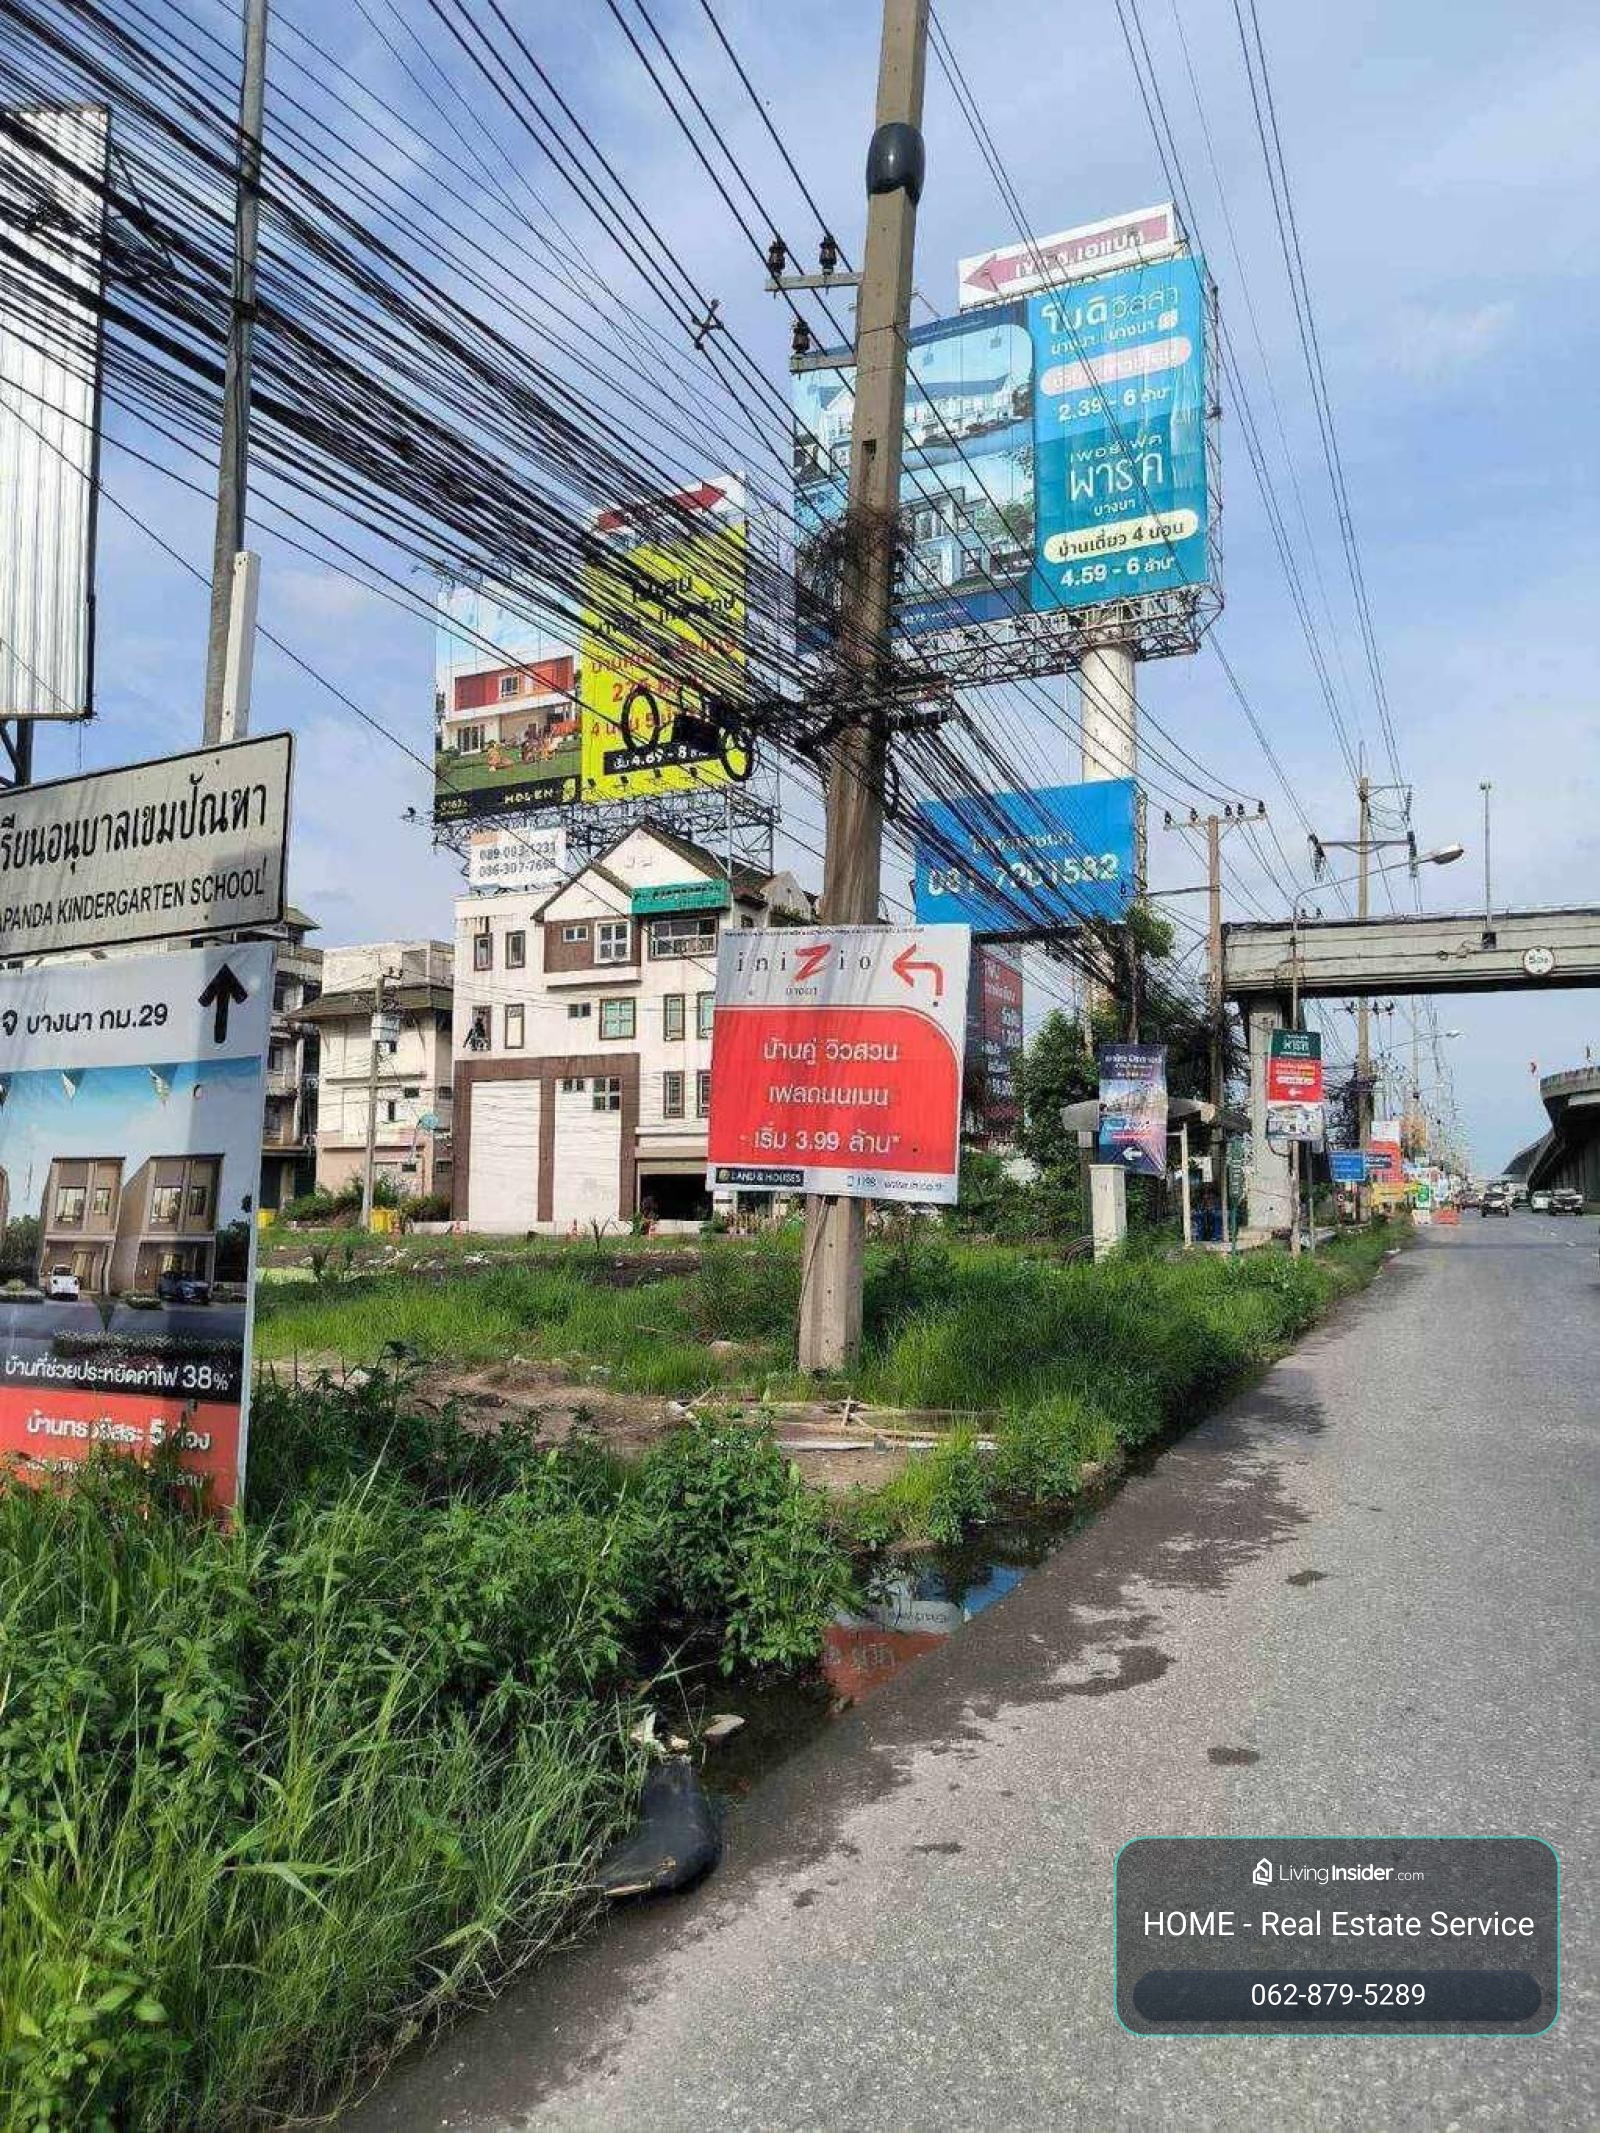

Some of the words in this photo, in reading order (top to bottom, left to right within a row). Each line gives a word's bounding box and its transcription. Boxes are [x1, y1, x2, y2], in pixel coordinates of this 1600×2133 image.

[1123, 388, 1136, 406] 6
[1132, 526, 1144, 542] 4
[1126, 557, 1141, 576] 6
[0, 901, 53, 933] PANDA
[57, 879, 186, 925] KINDERGARTEN
[190, 868, 265, 906] SCHOOL
[27, 1012, 93, 1034] บางนา
[99, 1002, 168, 1029] กม.29
[763, 1037, 817, 1065] บ้านคู่
[795, 1131, 839, 1151] 3.99
[5, 1352, 179, 1387] บ้านที่ช่วยประหยัดค่าไฟ
